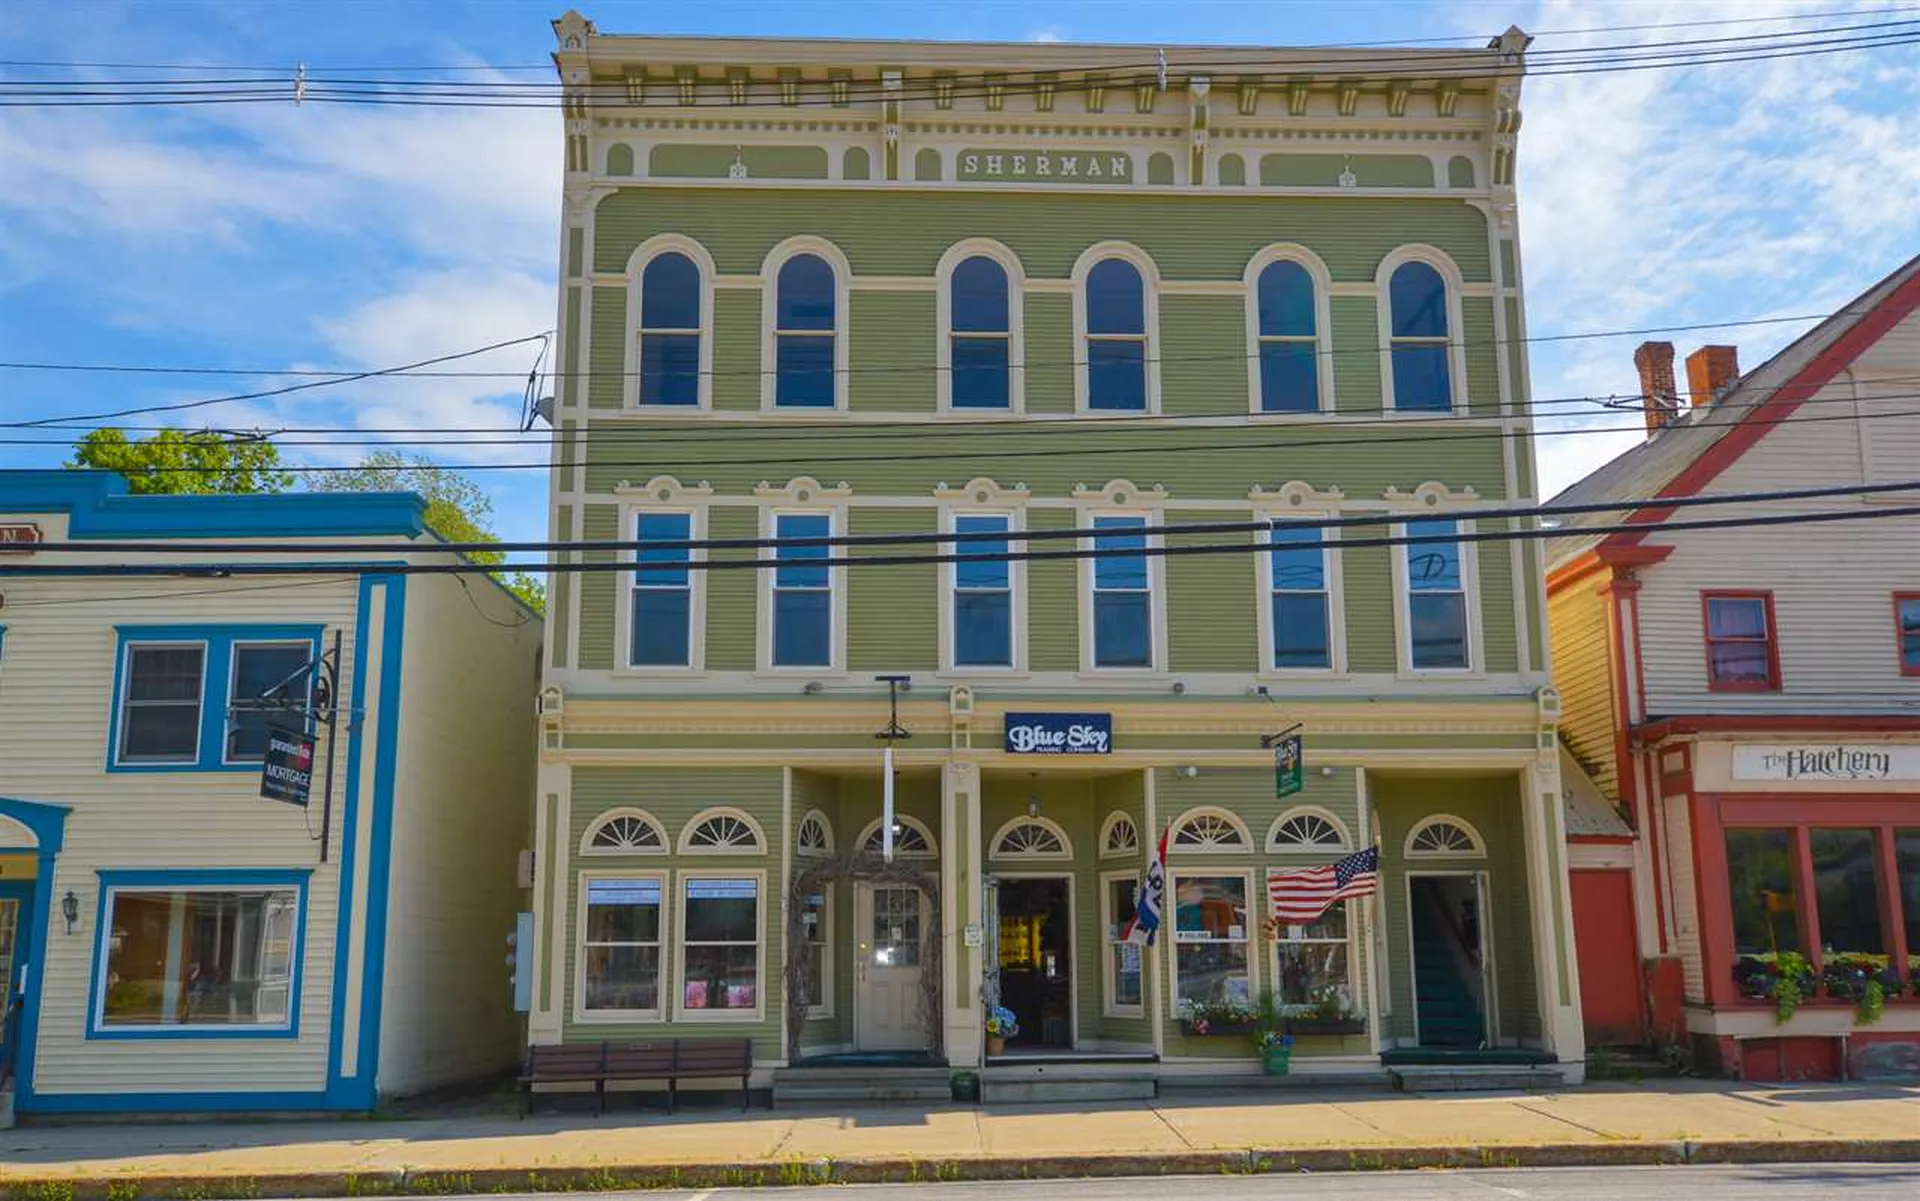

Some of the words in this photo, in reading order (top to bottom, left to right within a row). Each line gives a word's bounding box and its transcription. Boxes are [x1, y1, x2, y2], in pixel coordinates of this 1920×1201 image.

[964, 154, 1125, 177] SHERMAN
[1009, 725, 1066, 752] Blue
[1067, 725, 1108, 752] Sky
[1786, 747, 1890, 778] Hatchery
